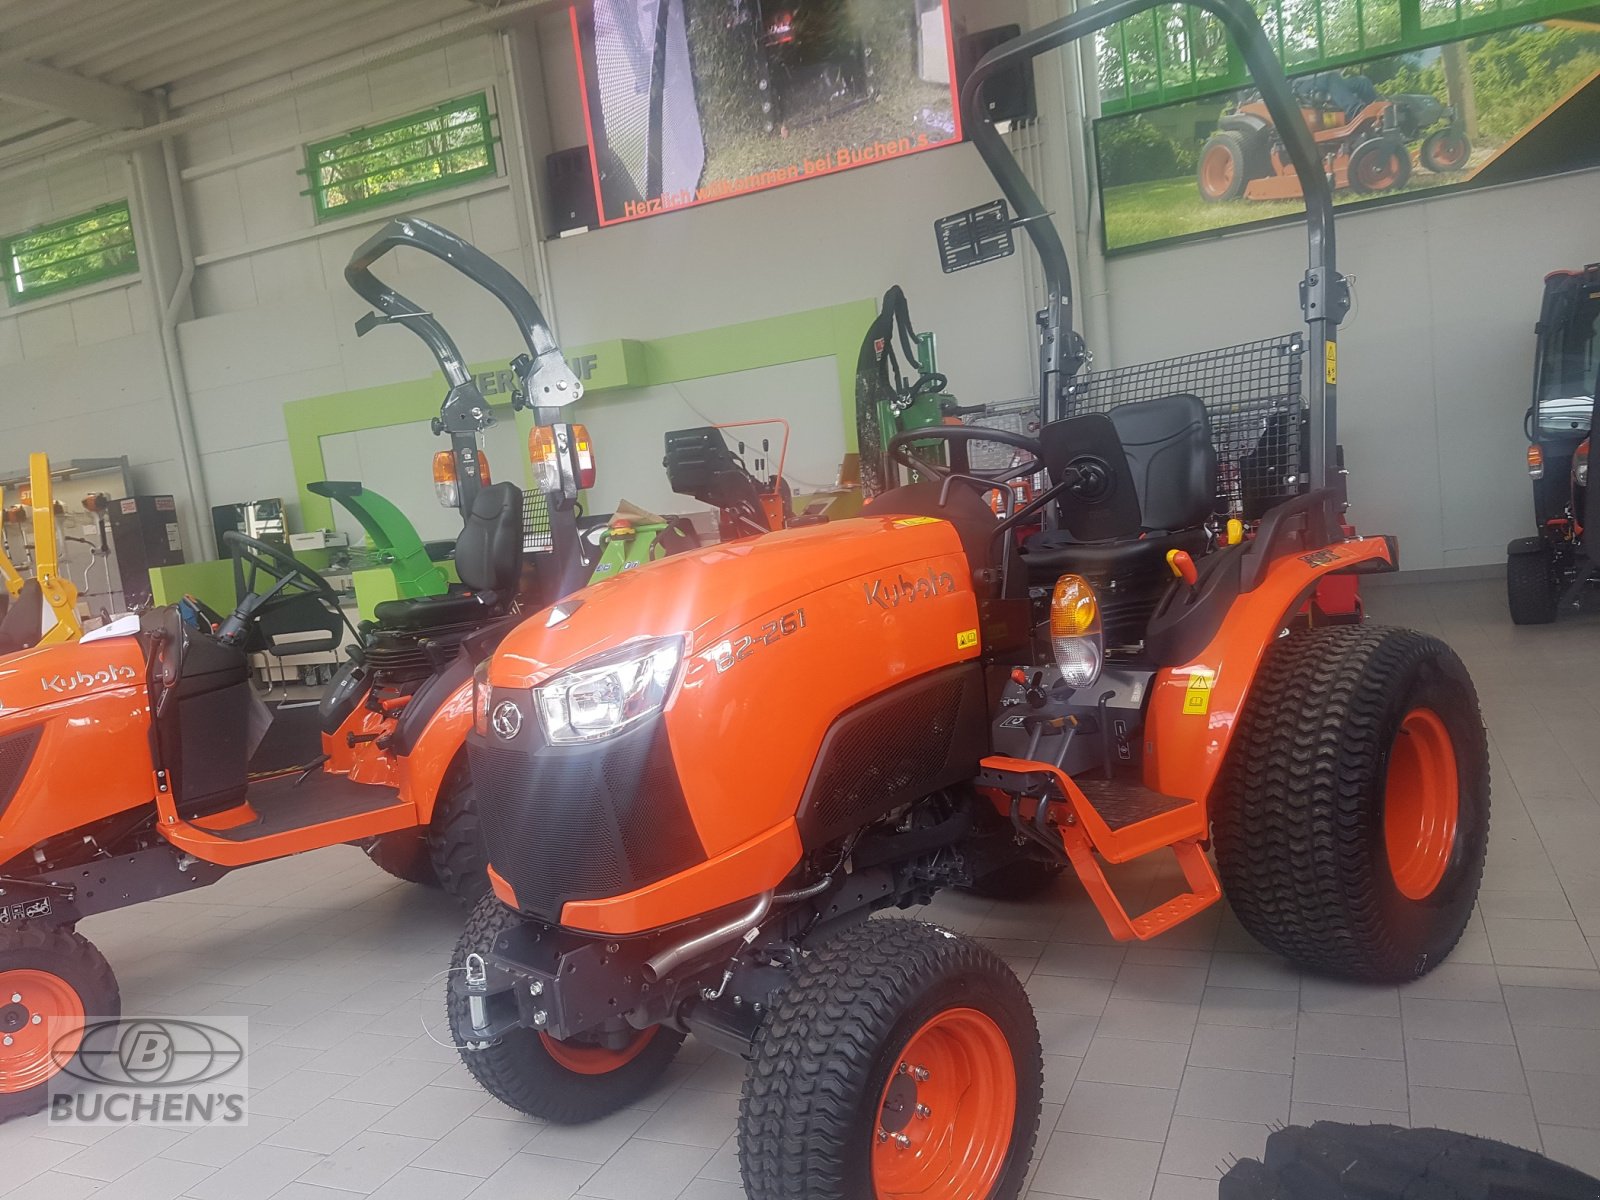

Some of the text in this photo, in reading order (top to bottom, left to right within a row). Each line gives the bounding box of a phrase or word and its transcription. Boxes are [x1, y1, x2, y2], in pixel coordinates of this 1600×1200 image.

[623, 188, 692, 217] Herzlich
[804, 150, 832, 175] bei
[863, 567, 956, 610] Kubota
[41, 664, 136, 693] Kubota
